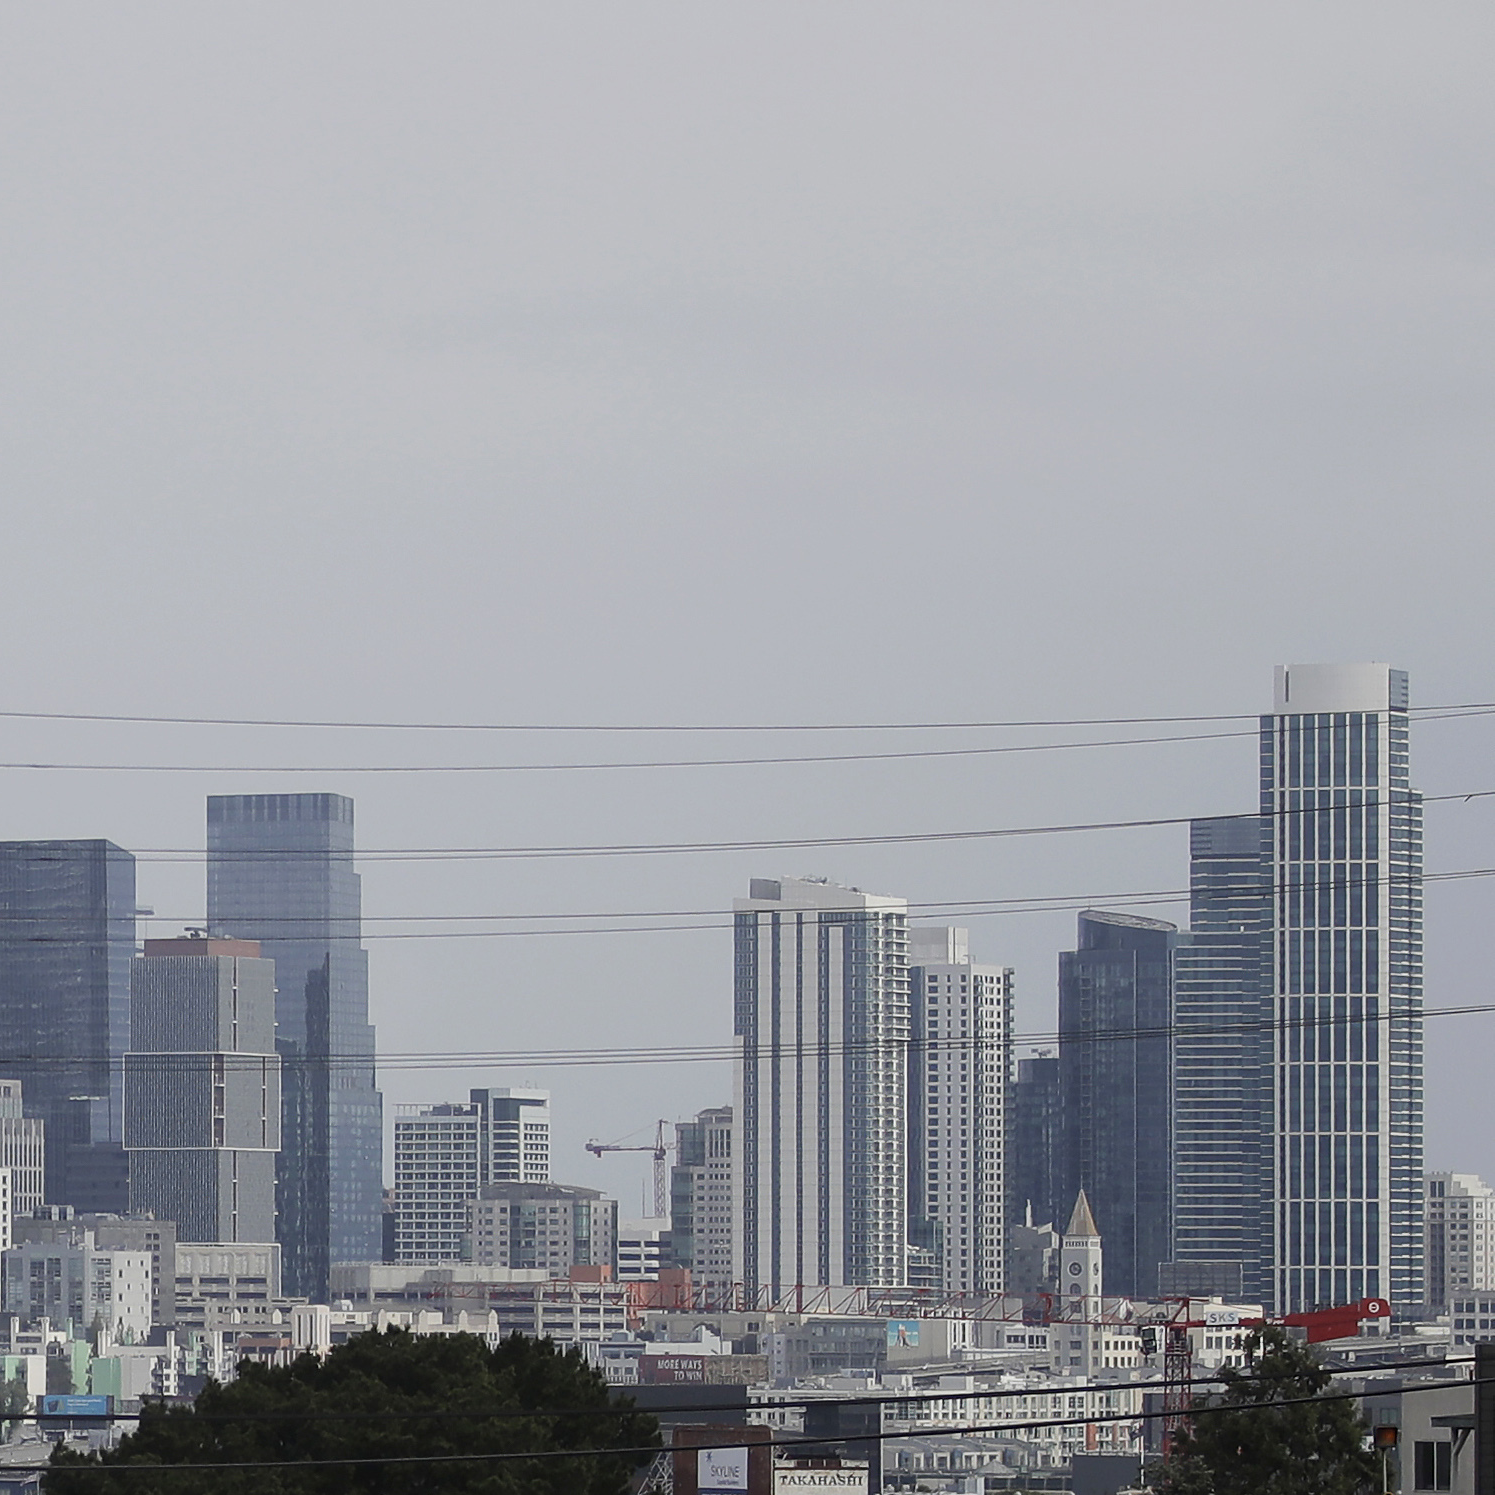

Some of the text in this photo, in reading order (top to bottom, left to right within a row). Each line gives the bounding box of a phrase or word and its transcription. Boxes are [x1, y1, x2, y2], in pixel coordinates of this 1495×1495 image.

[1210, 1313, 1235, 1323] SKS
[657, 1360, 702, 1370] MORE WAYS
[674, 1371, 702, 1380] TO WIN
[779, 1475, 863, 1487] TAKAHASHI
